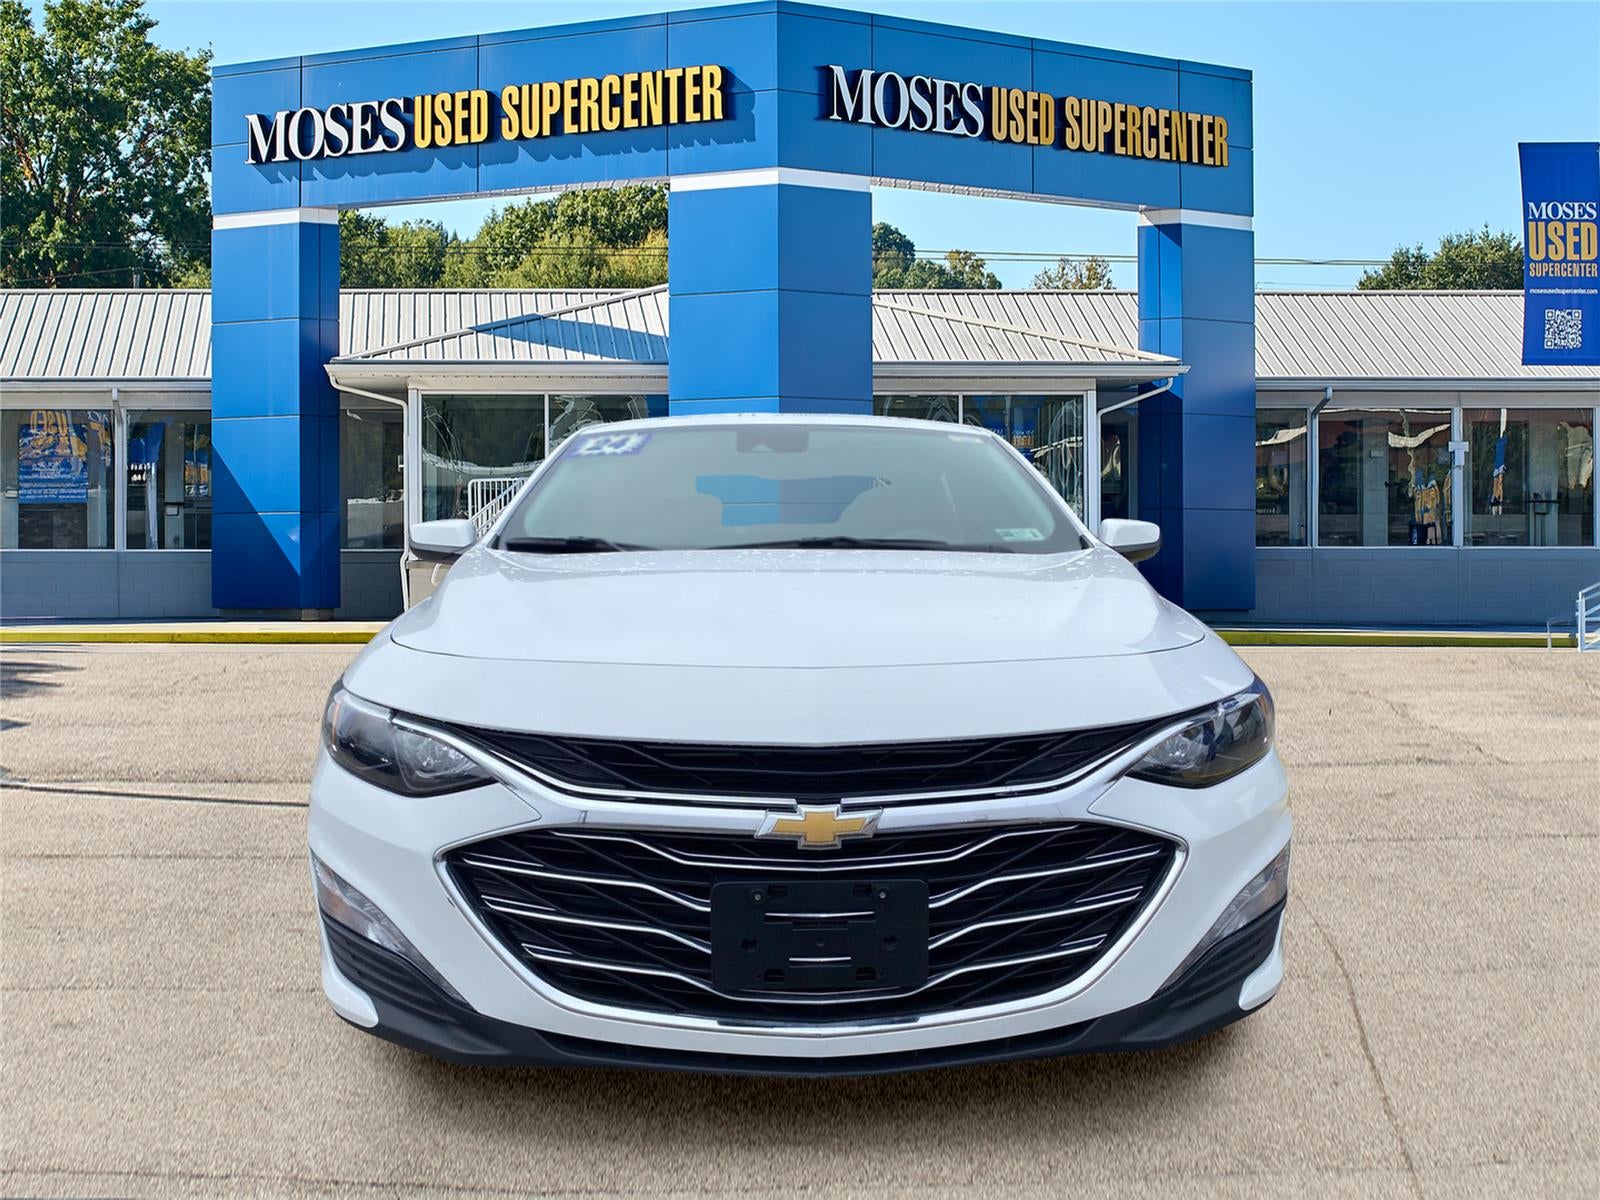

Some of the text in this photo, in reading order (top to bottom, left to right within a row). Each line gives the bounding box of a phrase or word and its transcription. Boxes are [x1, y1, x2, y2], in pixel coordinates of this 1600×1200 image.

[244, 64, 724, 165] MOSES USED SUPERCENTER
[829, 64, 1229, 167] MOSES USED SUPERCENTER
[1527, 201, 1597, 220] MOSES
[1528, 221, 1598, 261] USED
[1529, 263, 1598, 277] SUPERCENTER
